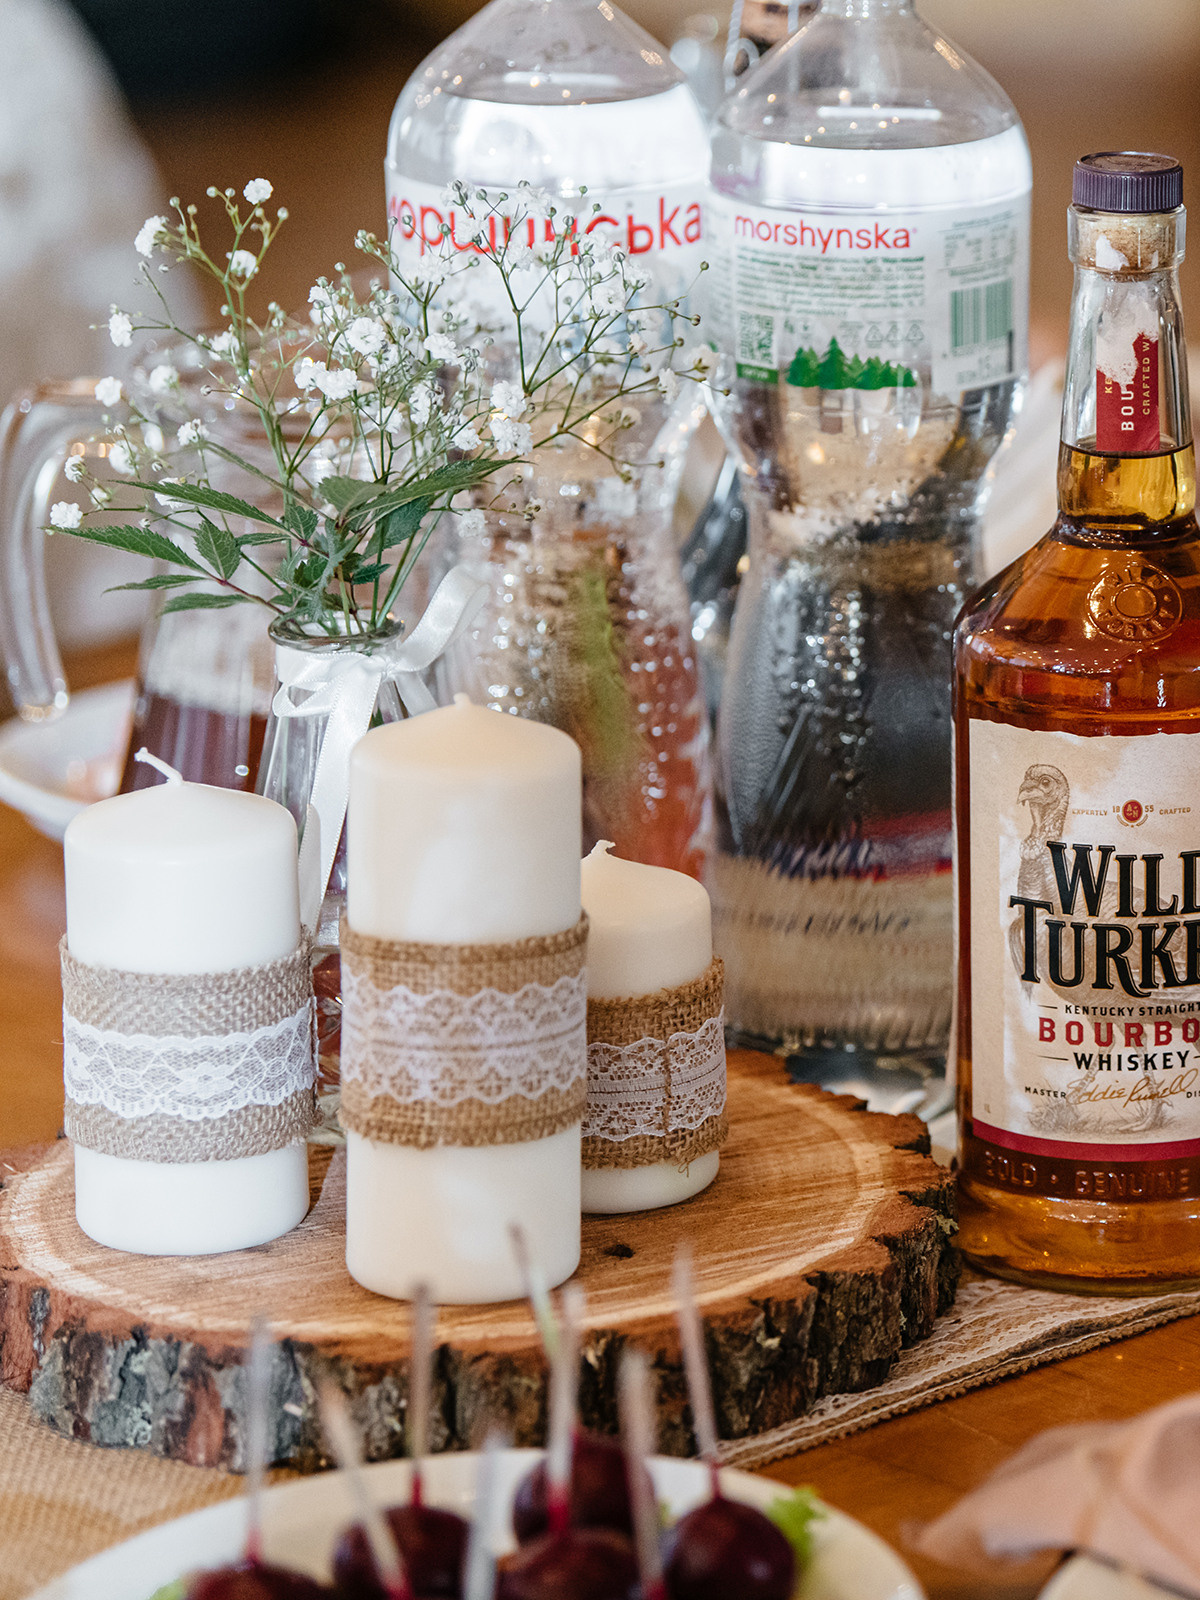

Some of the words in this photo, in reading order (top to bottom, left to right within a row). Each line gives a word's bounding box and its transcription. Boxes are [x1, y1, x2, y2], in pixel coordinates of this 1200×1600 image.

[735, 215, 911, 254] morshynska
[1142, 357, 1150, 415] CRAFTED
[1072, 808, 1108, 817] EXPERTLY
[1112, 805, 1120, 813] 18
[1144, 804, 1154, 813] 55
[1159, 806, 1191, 816] CRAFTED
[1064, 1004, 1134, 1017] KENTUCKY
[1073, 1050, 1191, 1072] WHISKEY
[1024, 1085, 1067, 1099] MASTER
